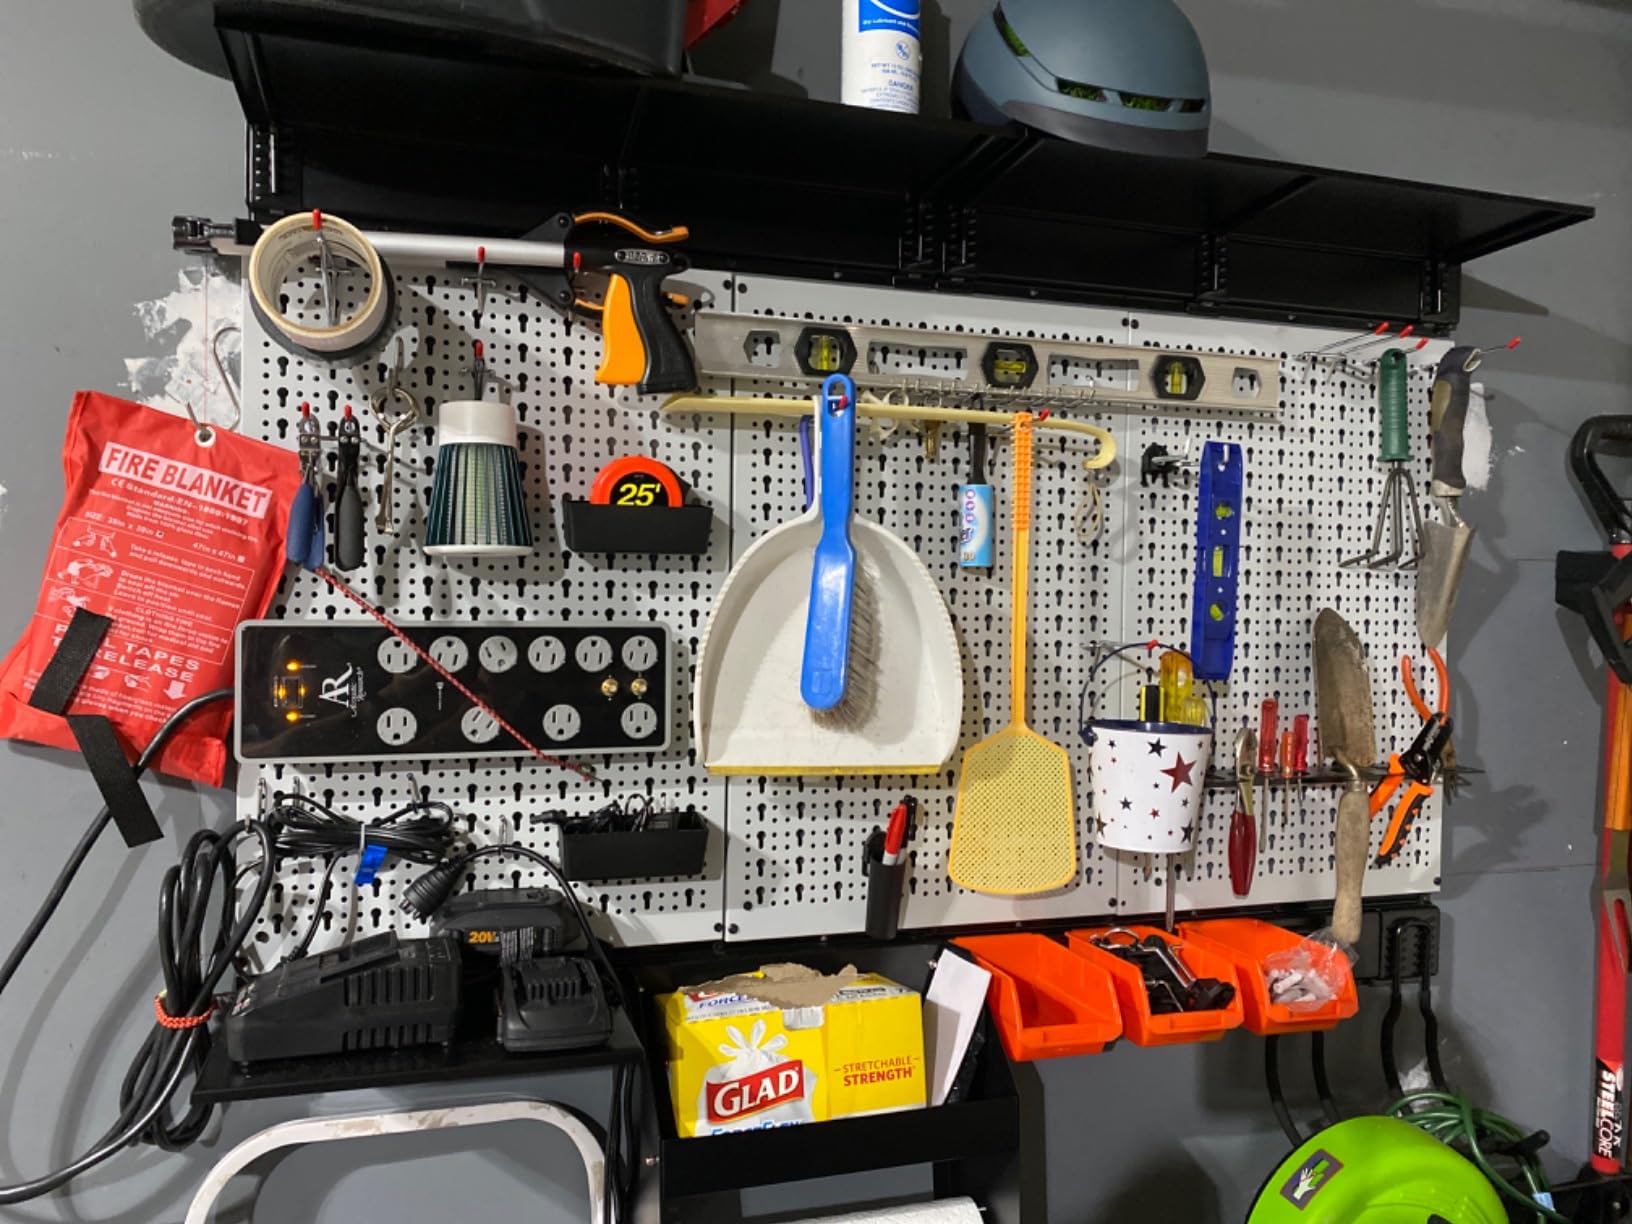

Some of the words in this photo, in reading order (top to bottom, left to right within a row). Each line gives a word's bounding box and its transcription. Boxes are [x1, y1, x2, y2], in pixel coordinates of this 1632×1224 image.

[105, 447, 160, 481] FIRE
[161, 464, 265, 511] BLANKET
[616, 482, 661, 507] 25'
[124, 641, 200, 671] TAPES
[842, 1056, 912, 1073] STRETCHABLE
[843, 1067, 913, 1088] STRENGTH
[713, 1069, 800, 1117] GLAD
